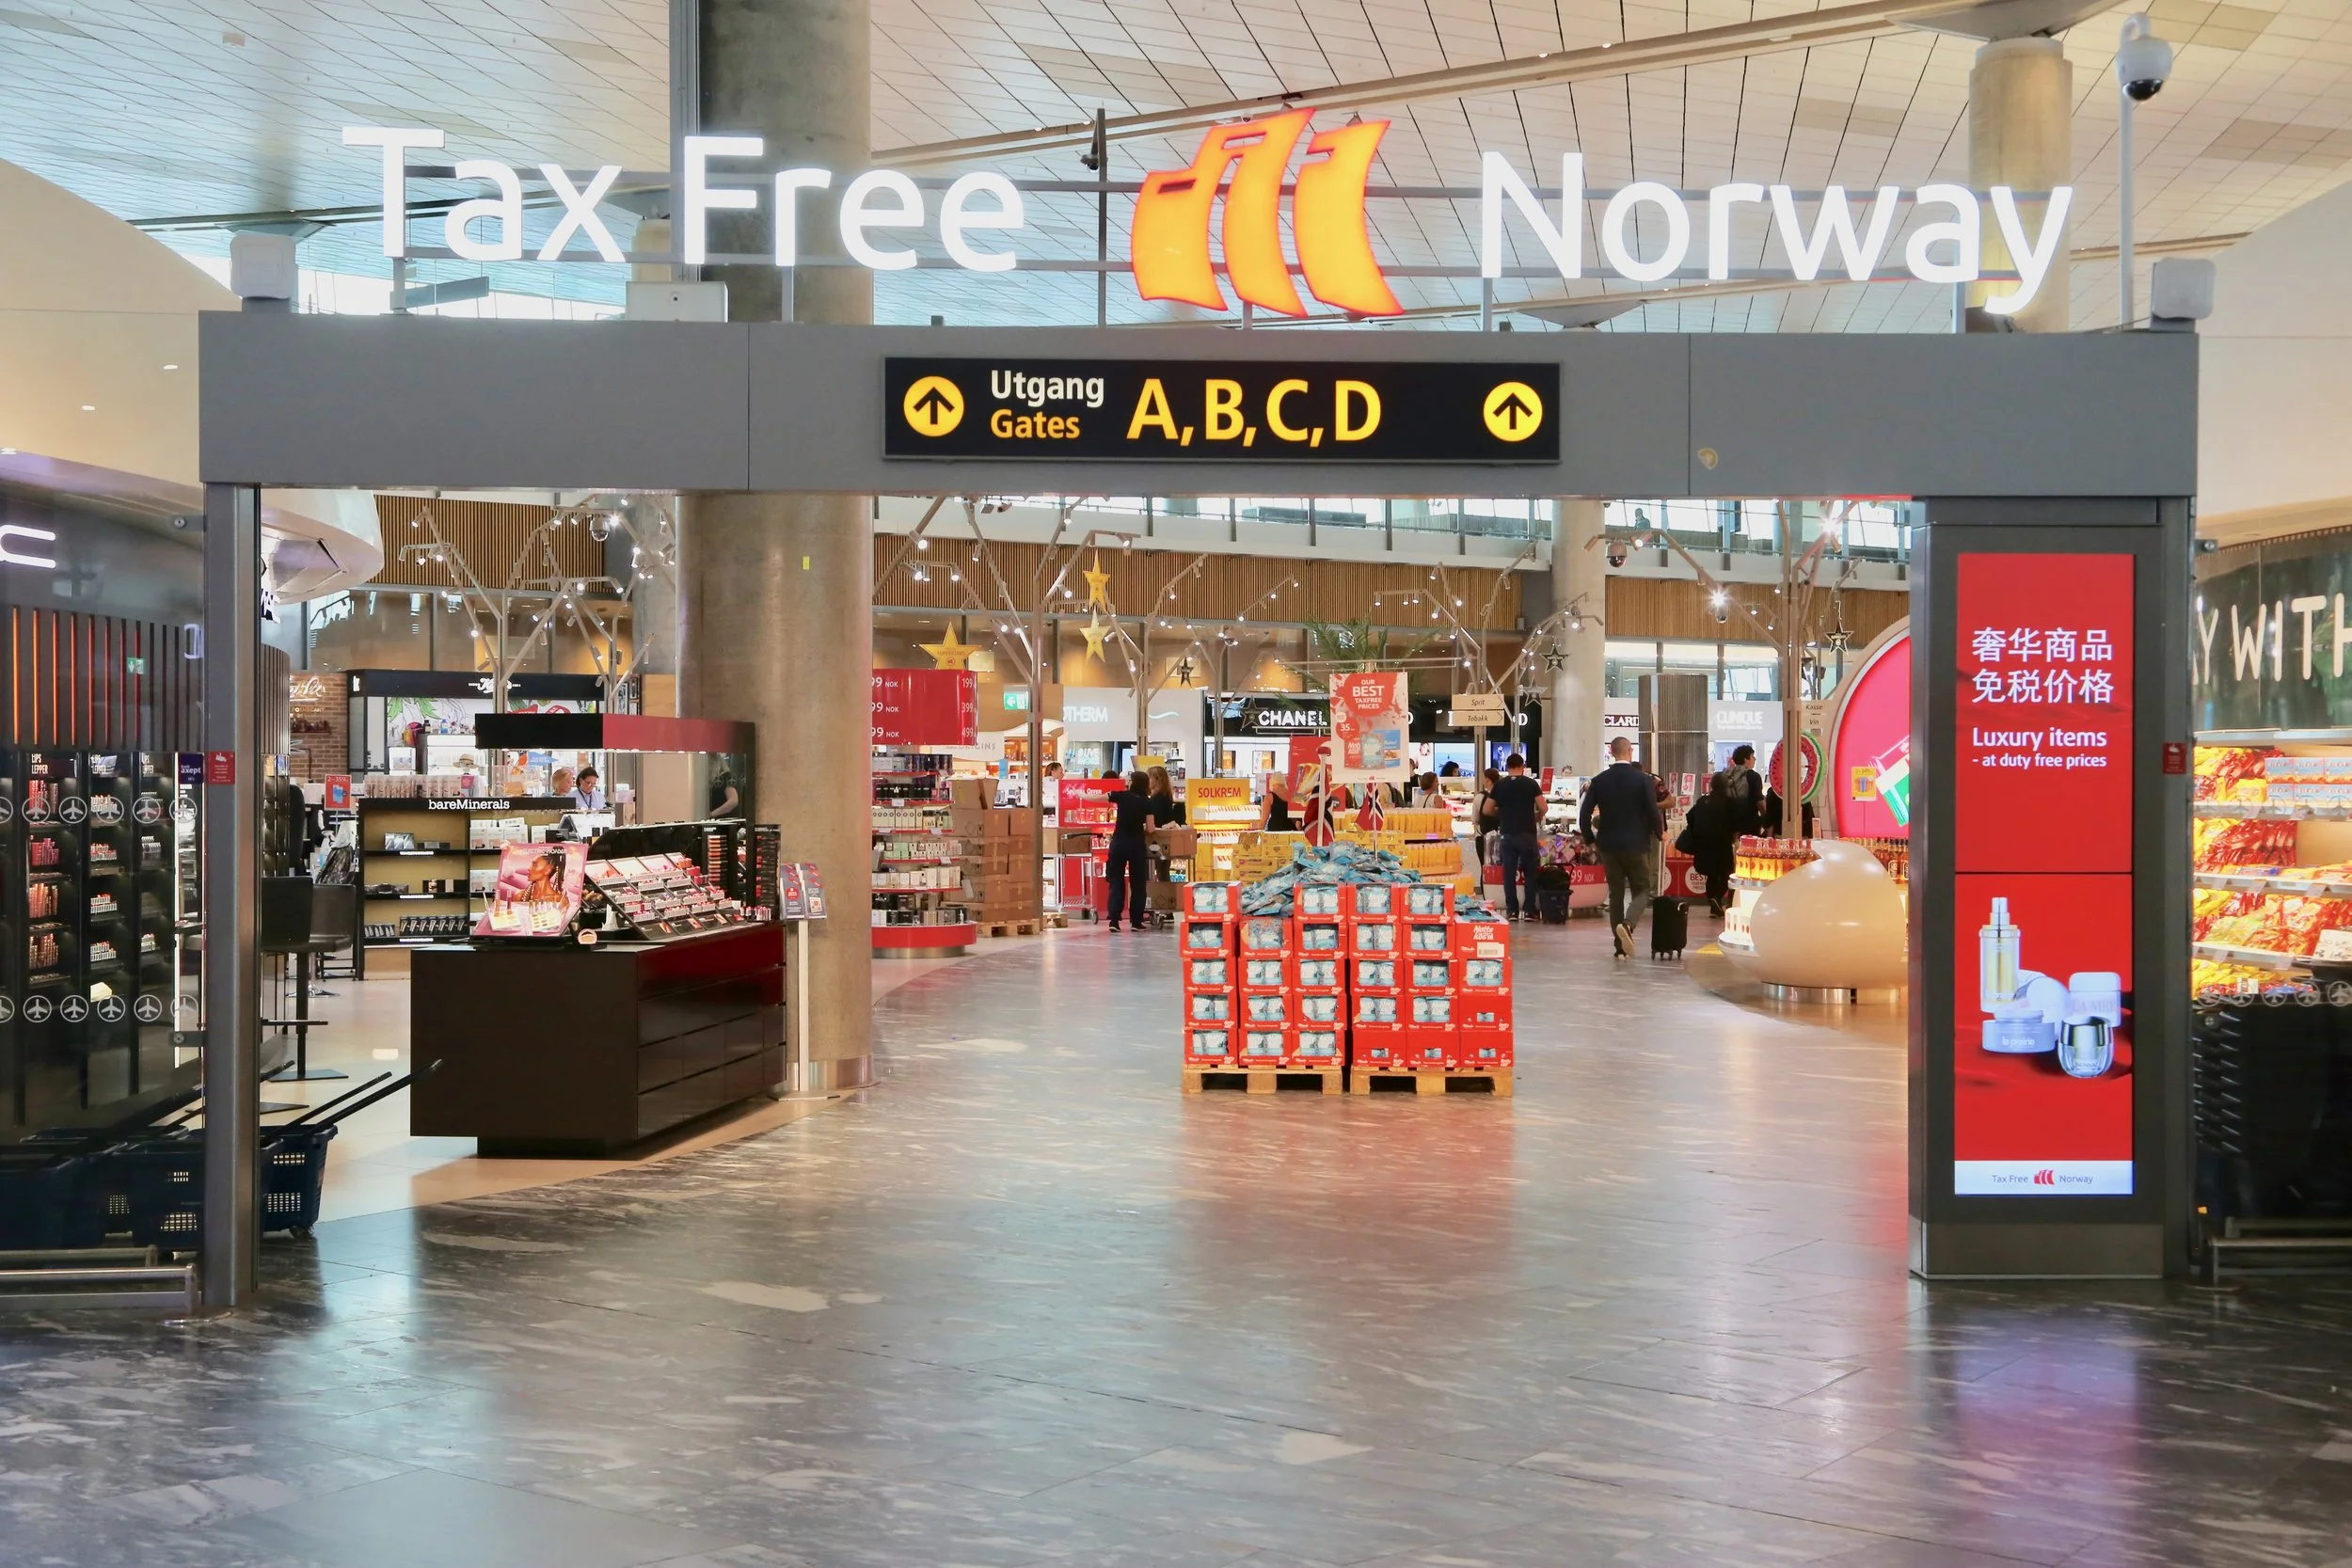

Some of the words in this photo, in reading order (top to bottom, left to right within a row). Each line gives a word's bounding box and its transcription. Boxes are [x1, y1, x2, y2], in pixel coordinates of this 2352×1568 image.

[342, 126, 626, 262] Tax
[683, 135, 1025, 273] Free
[1480, 150, 2073, 315] Norway
[991, 369, 1104, 407] Utgang
[991, 408, 1080, 439] Gates
[1971, 626, 2113, 662] 奢华商品
[2193, 608, 2219, 685] Y
[1352, 686, 1385, 697] BEST
[1971, 668, 2115, 704] 免税价格
[1258, 709, 1327, 726] CHANEL
[1604, 716, 1639, 726] CLARI
[1972, 727, 2043, 752] Luxury
[2049, 727, 2107, 747] items
[1981, 754, 1996, 767] at
[1999, 753, 2031, 769] duty
[2034, 753, 2062, 767] free
[2066, 753, 2107, 769] prices
[1198, 786, 1241, 798] SOLKREM
[428, 800, 510, 810] bareMinerals
[1992, 1175, 2007, 1183] Tax
[2009, 1175, 2028, 1183] Free
[2059, 1175, 2093, 1185] Norway
